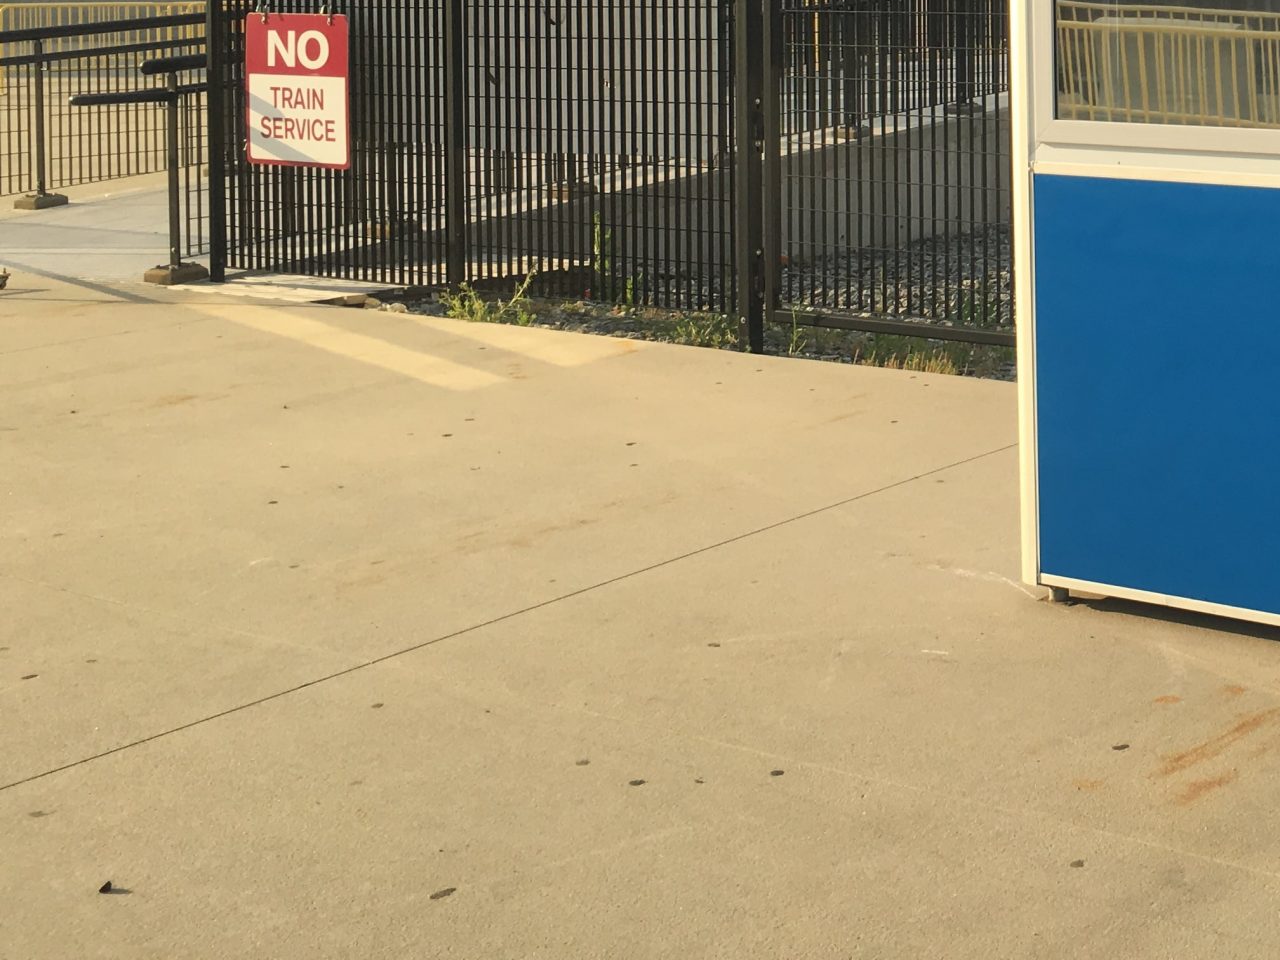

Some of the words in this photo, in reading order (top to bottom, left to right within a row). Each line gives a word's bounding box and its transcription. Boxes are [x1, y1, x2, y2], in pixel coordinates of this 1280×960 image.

[267, 29, 330, 70] NO
[270, 86, 324, 111] TRAIN
[260, 116, 336, 142] SERVICE
